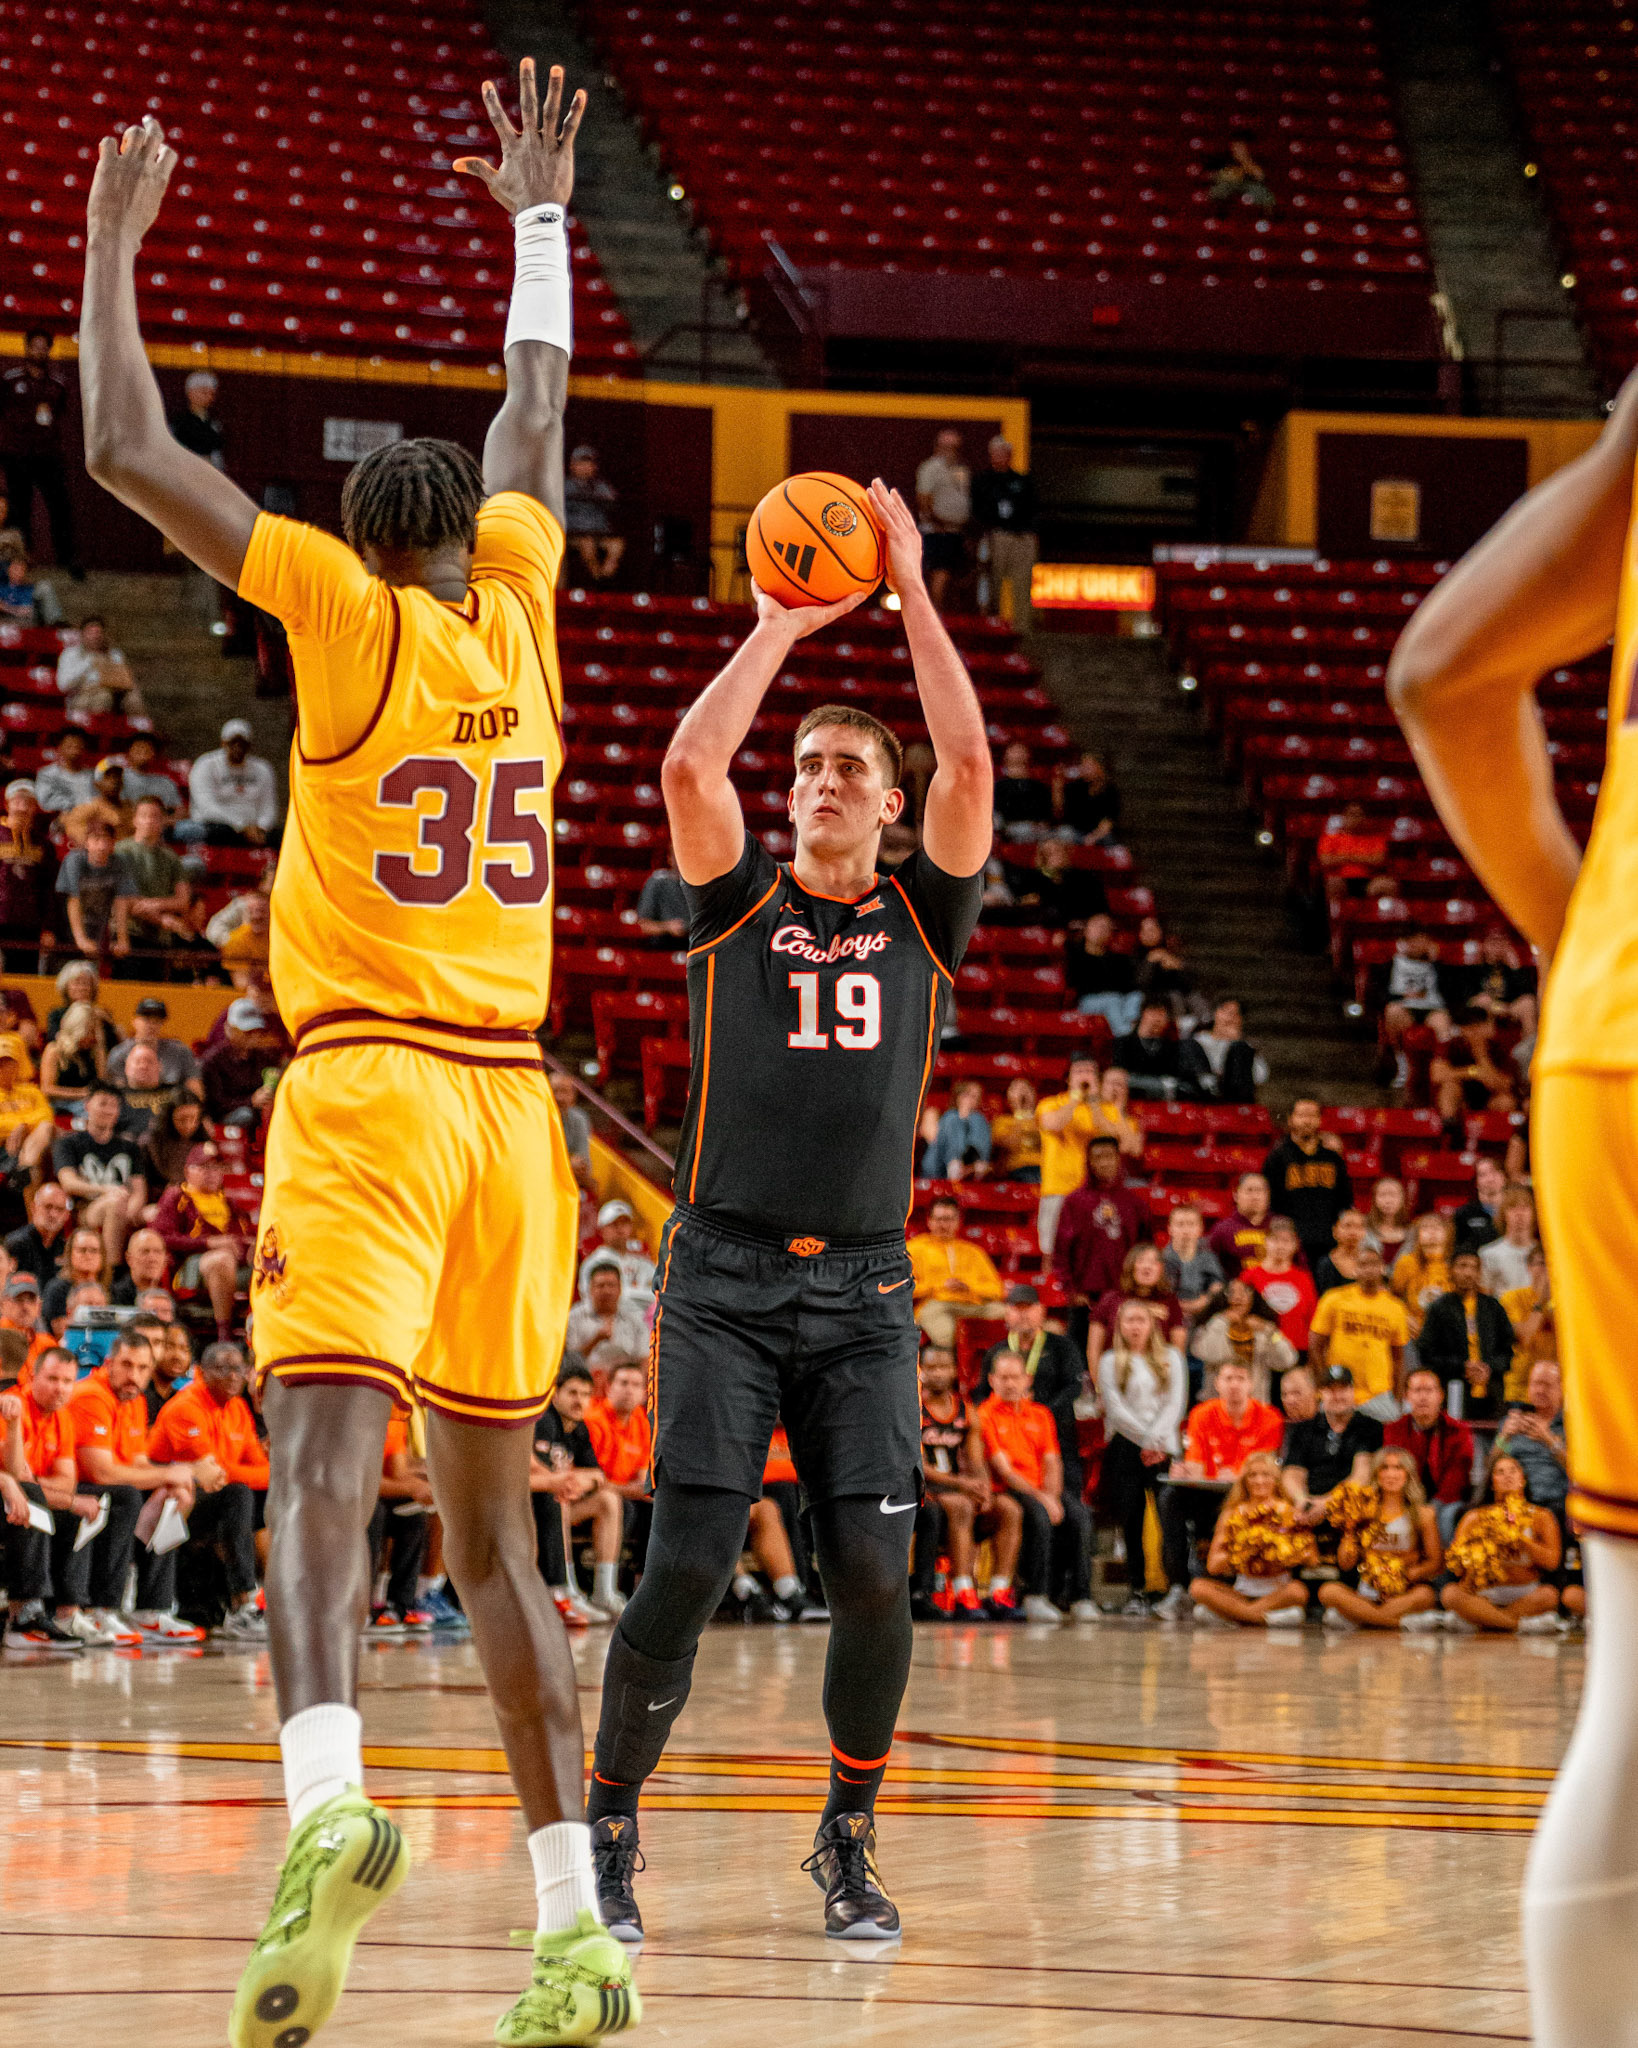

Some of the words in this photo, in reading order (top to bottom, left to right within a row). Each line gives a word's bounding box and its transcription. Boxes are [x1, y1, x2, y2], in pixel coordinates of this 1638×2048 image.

[372, 755, 550, 908] 35
[770, 924, 892, 964] Cowboys
[788, 971, 882, 1050] 19
